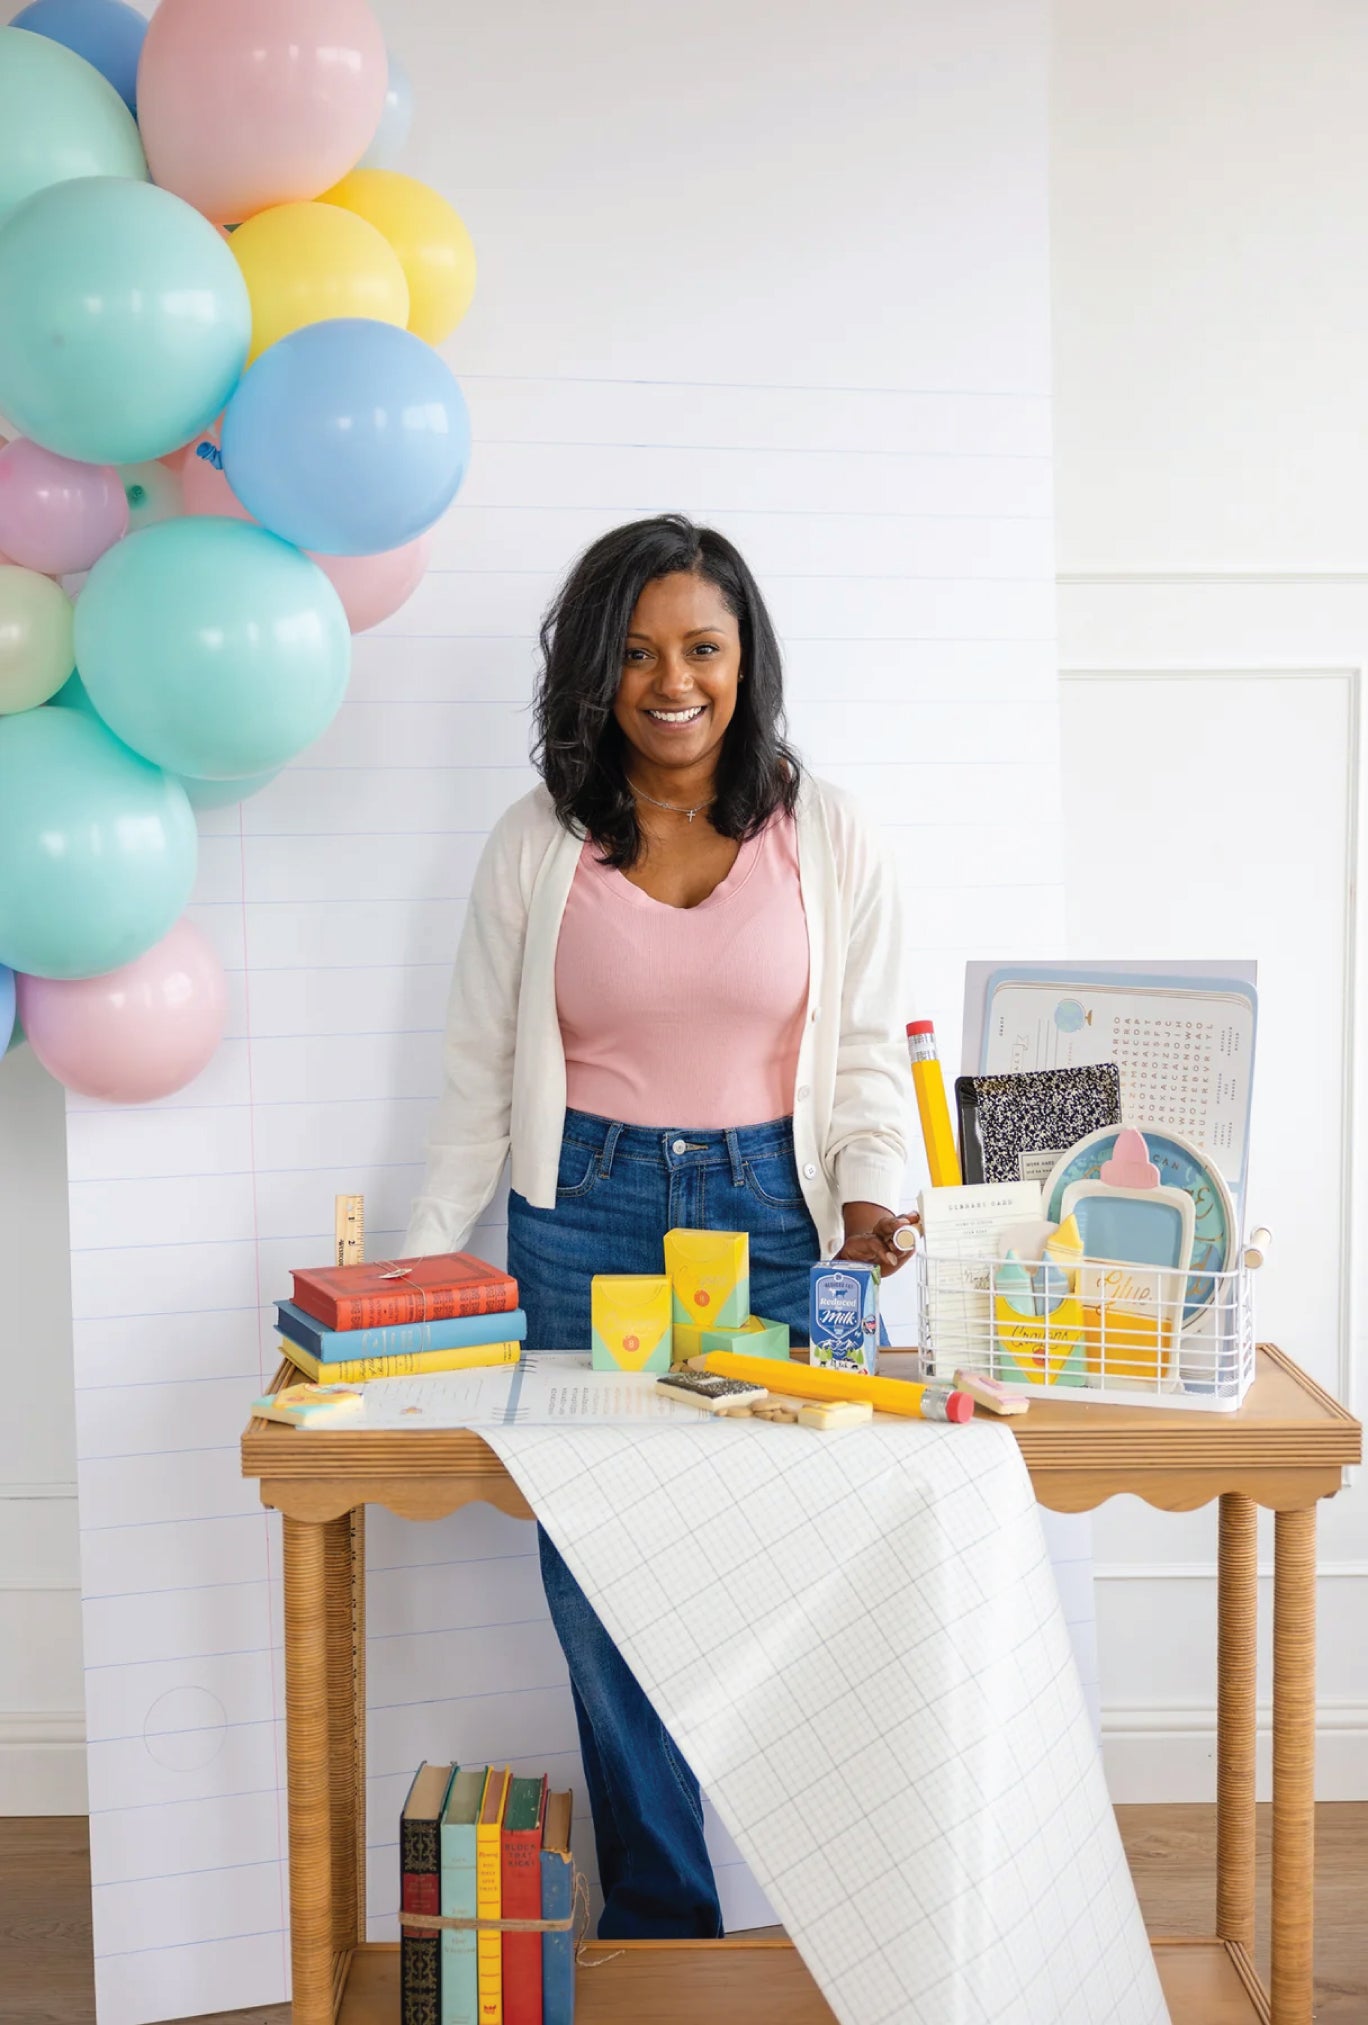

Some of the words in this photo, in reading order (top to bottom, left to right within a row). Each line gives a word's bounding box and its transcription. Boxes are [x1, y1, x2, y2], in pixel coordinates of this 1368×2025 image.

[1153, 1154, 1179, 1170] CAN
[820, 1297, 857, 1308] Reduced
[821, 1310, 855, 1326] Milk
[505, 1843, 536, 1851] BLOCK
